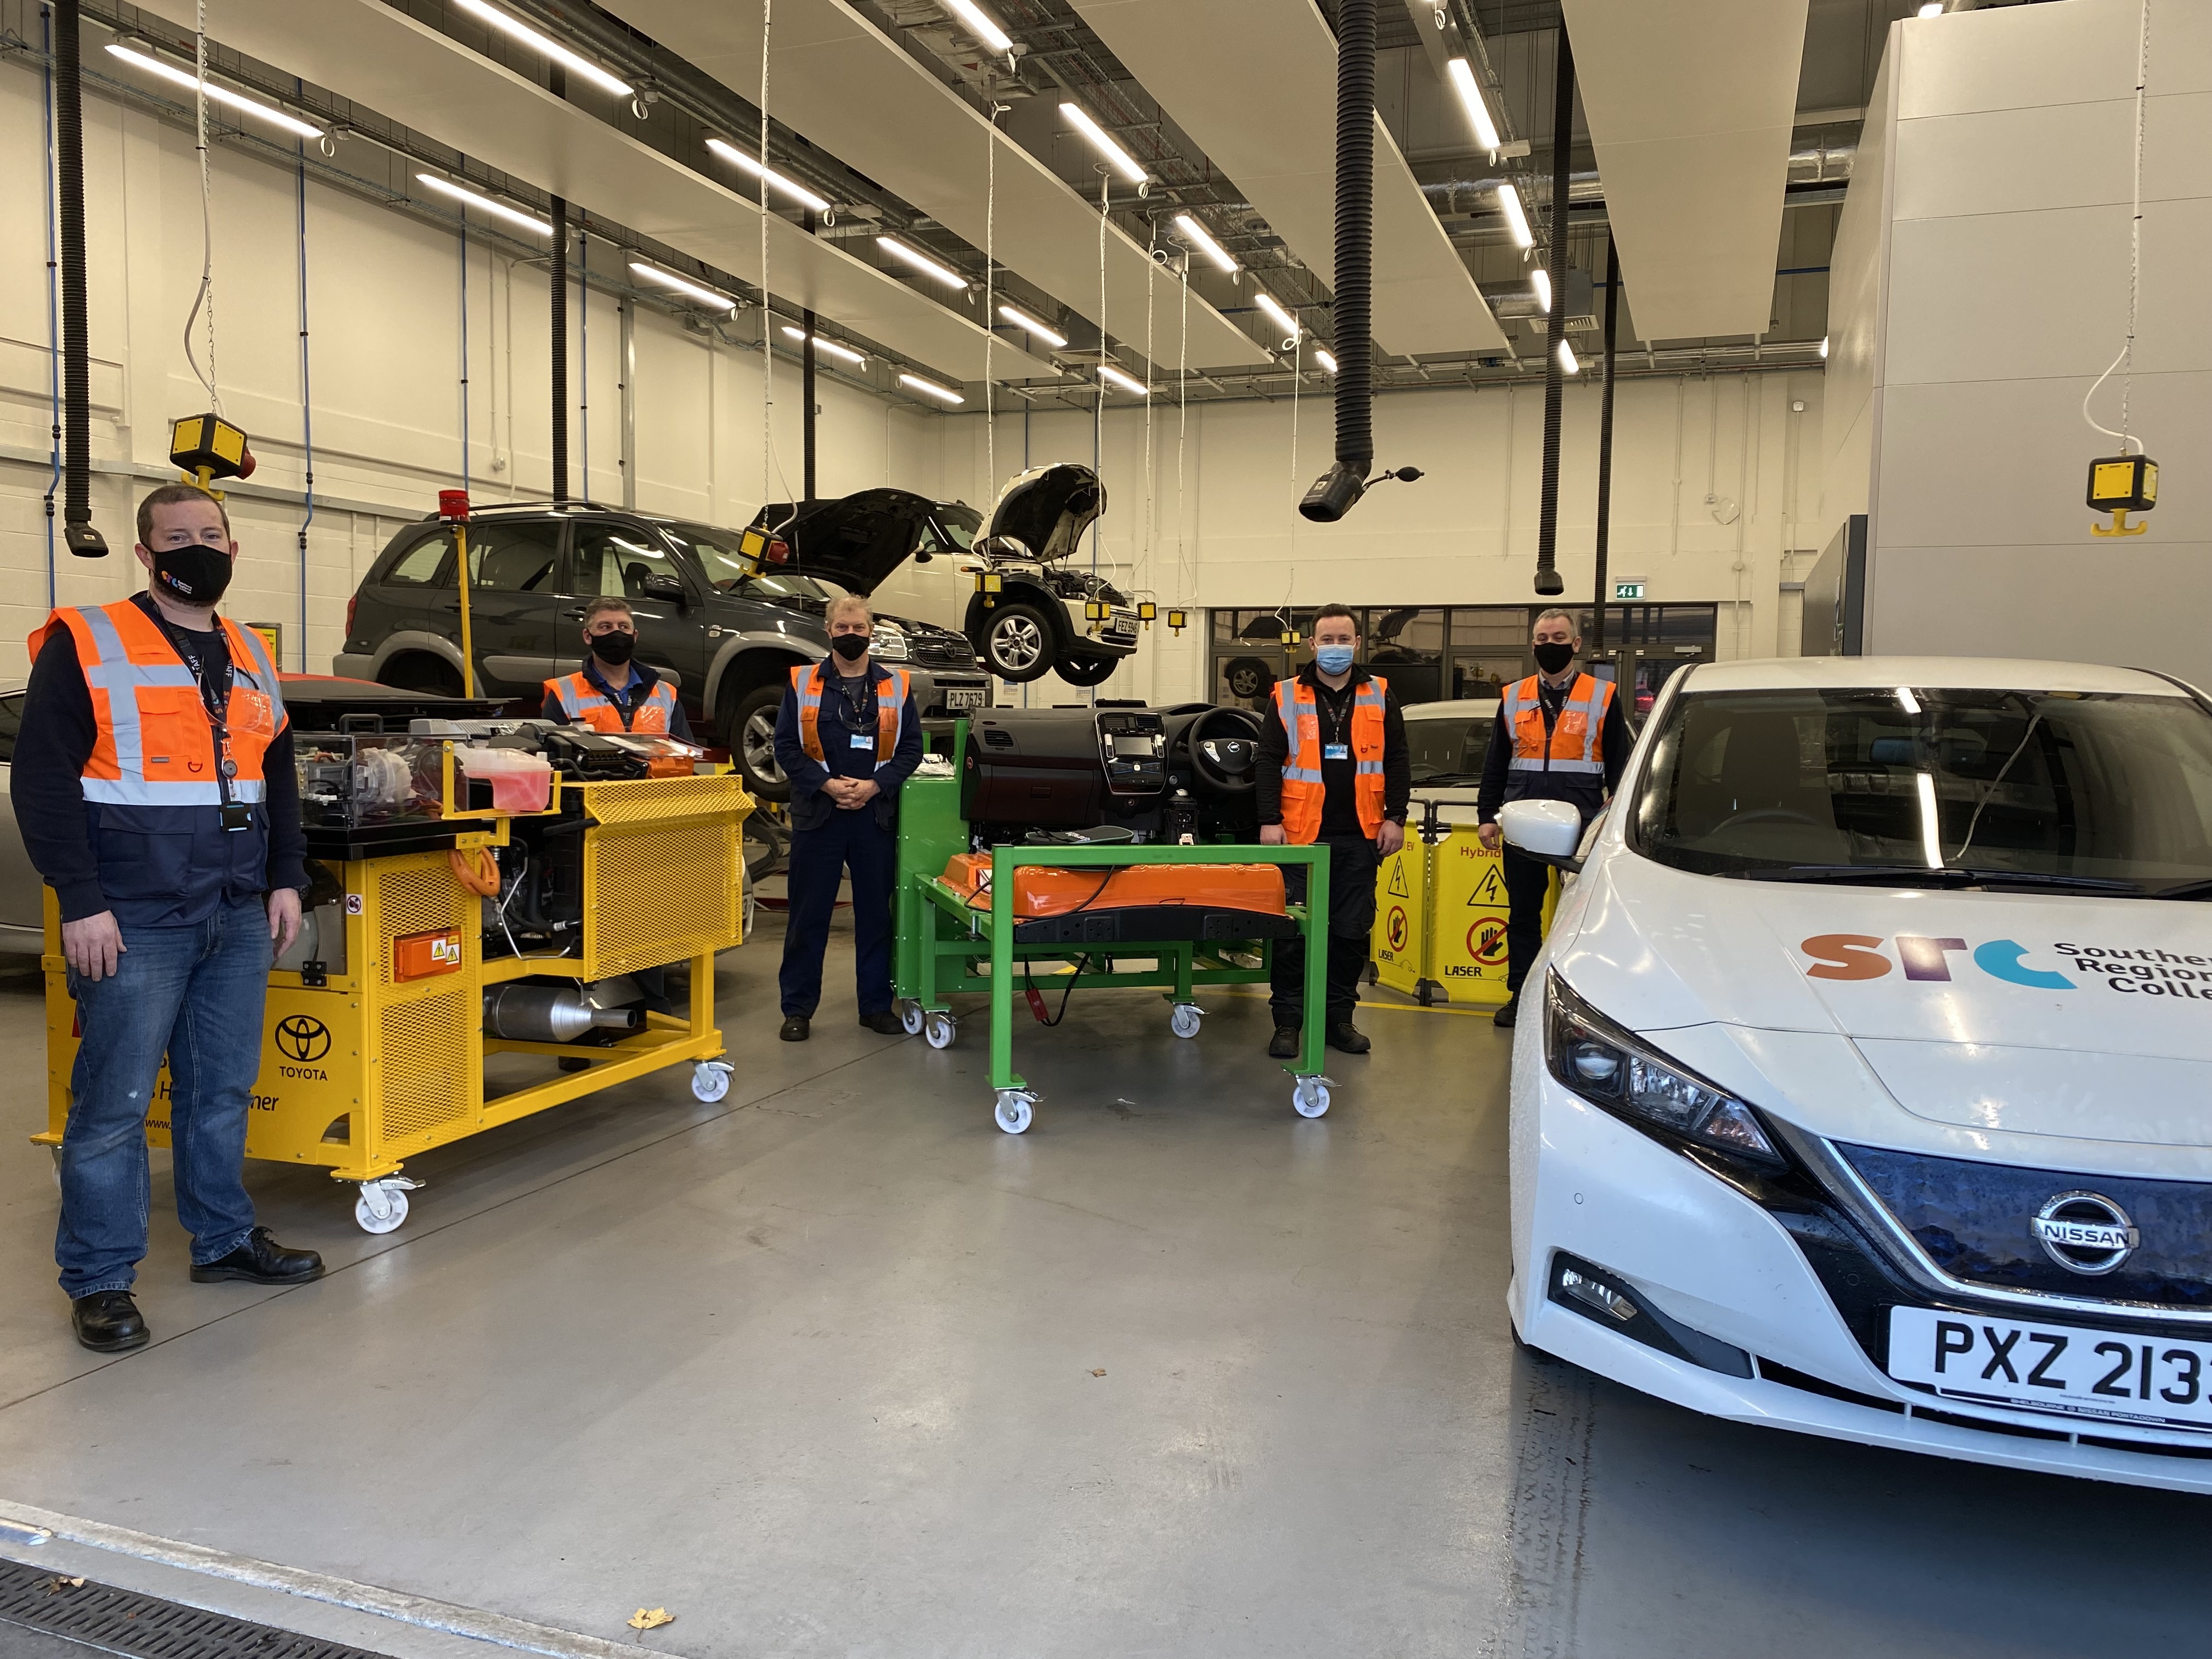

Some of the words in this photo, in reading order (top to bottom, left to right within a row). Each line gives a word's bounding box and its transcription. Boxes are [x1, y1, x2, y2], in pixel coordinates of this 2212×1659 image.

[161, 571, 178, 588] src
[1118, 620, 1128, 632] FEZ
[188, 654, 200, 670] TAFF
[950, 692, 963, 707] PLZ
[965, 692, 982, 706] 7679
[1407, 842, 1414, 851] EV
[1460, 847, 1501, 859] Hybrid
[1378, 949, 1394, 961] LASER
[1801, 934, 2079, 990] src
[2054, 943, 2212, 966] Southe
[1444, 965, 1482, 977] LASER
[279, 1066, 328, 1081] TOYOTA
[2044, 1224, 2130, 1246] NISSAN
[1934, 1320, 2068, 1390] PXZ
[2092, 1341, 2212, 1404] 213
[2112, 1412, 2166, 1423] PORTADOWN
